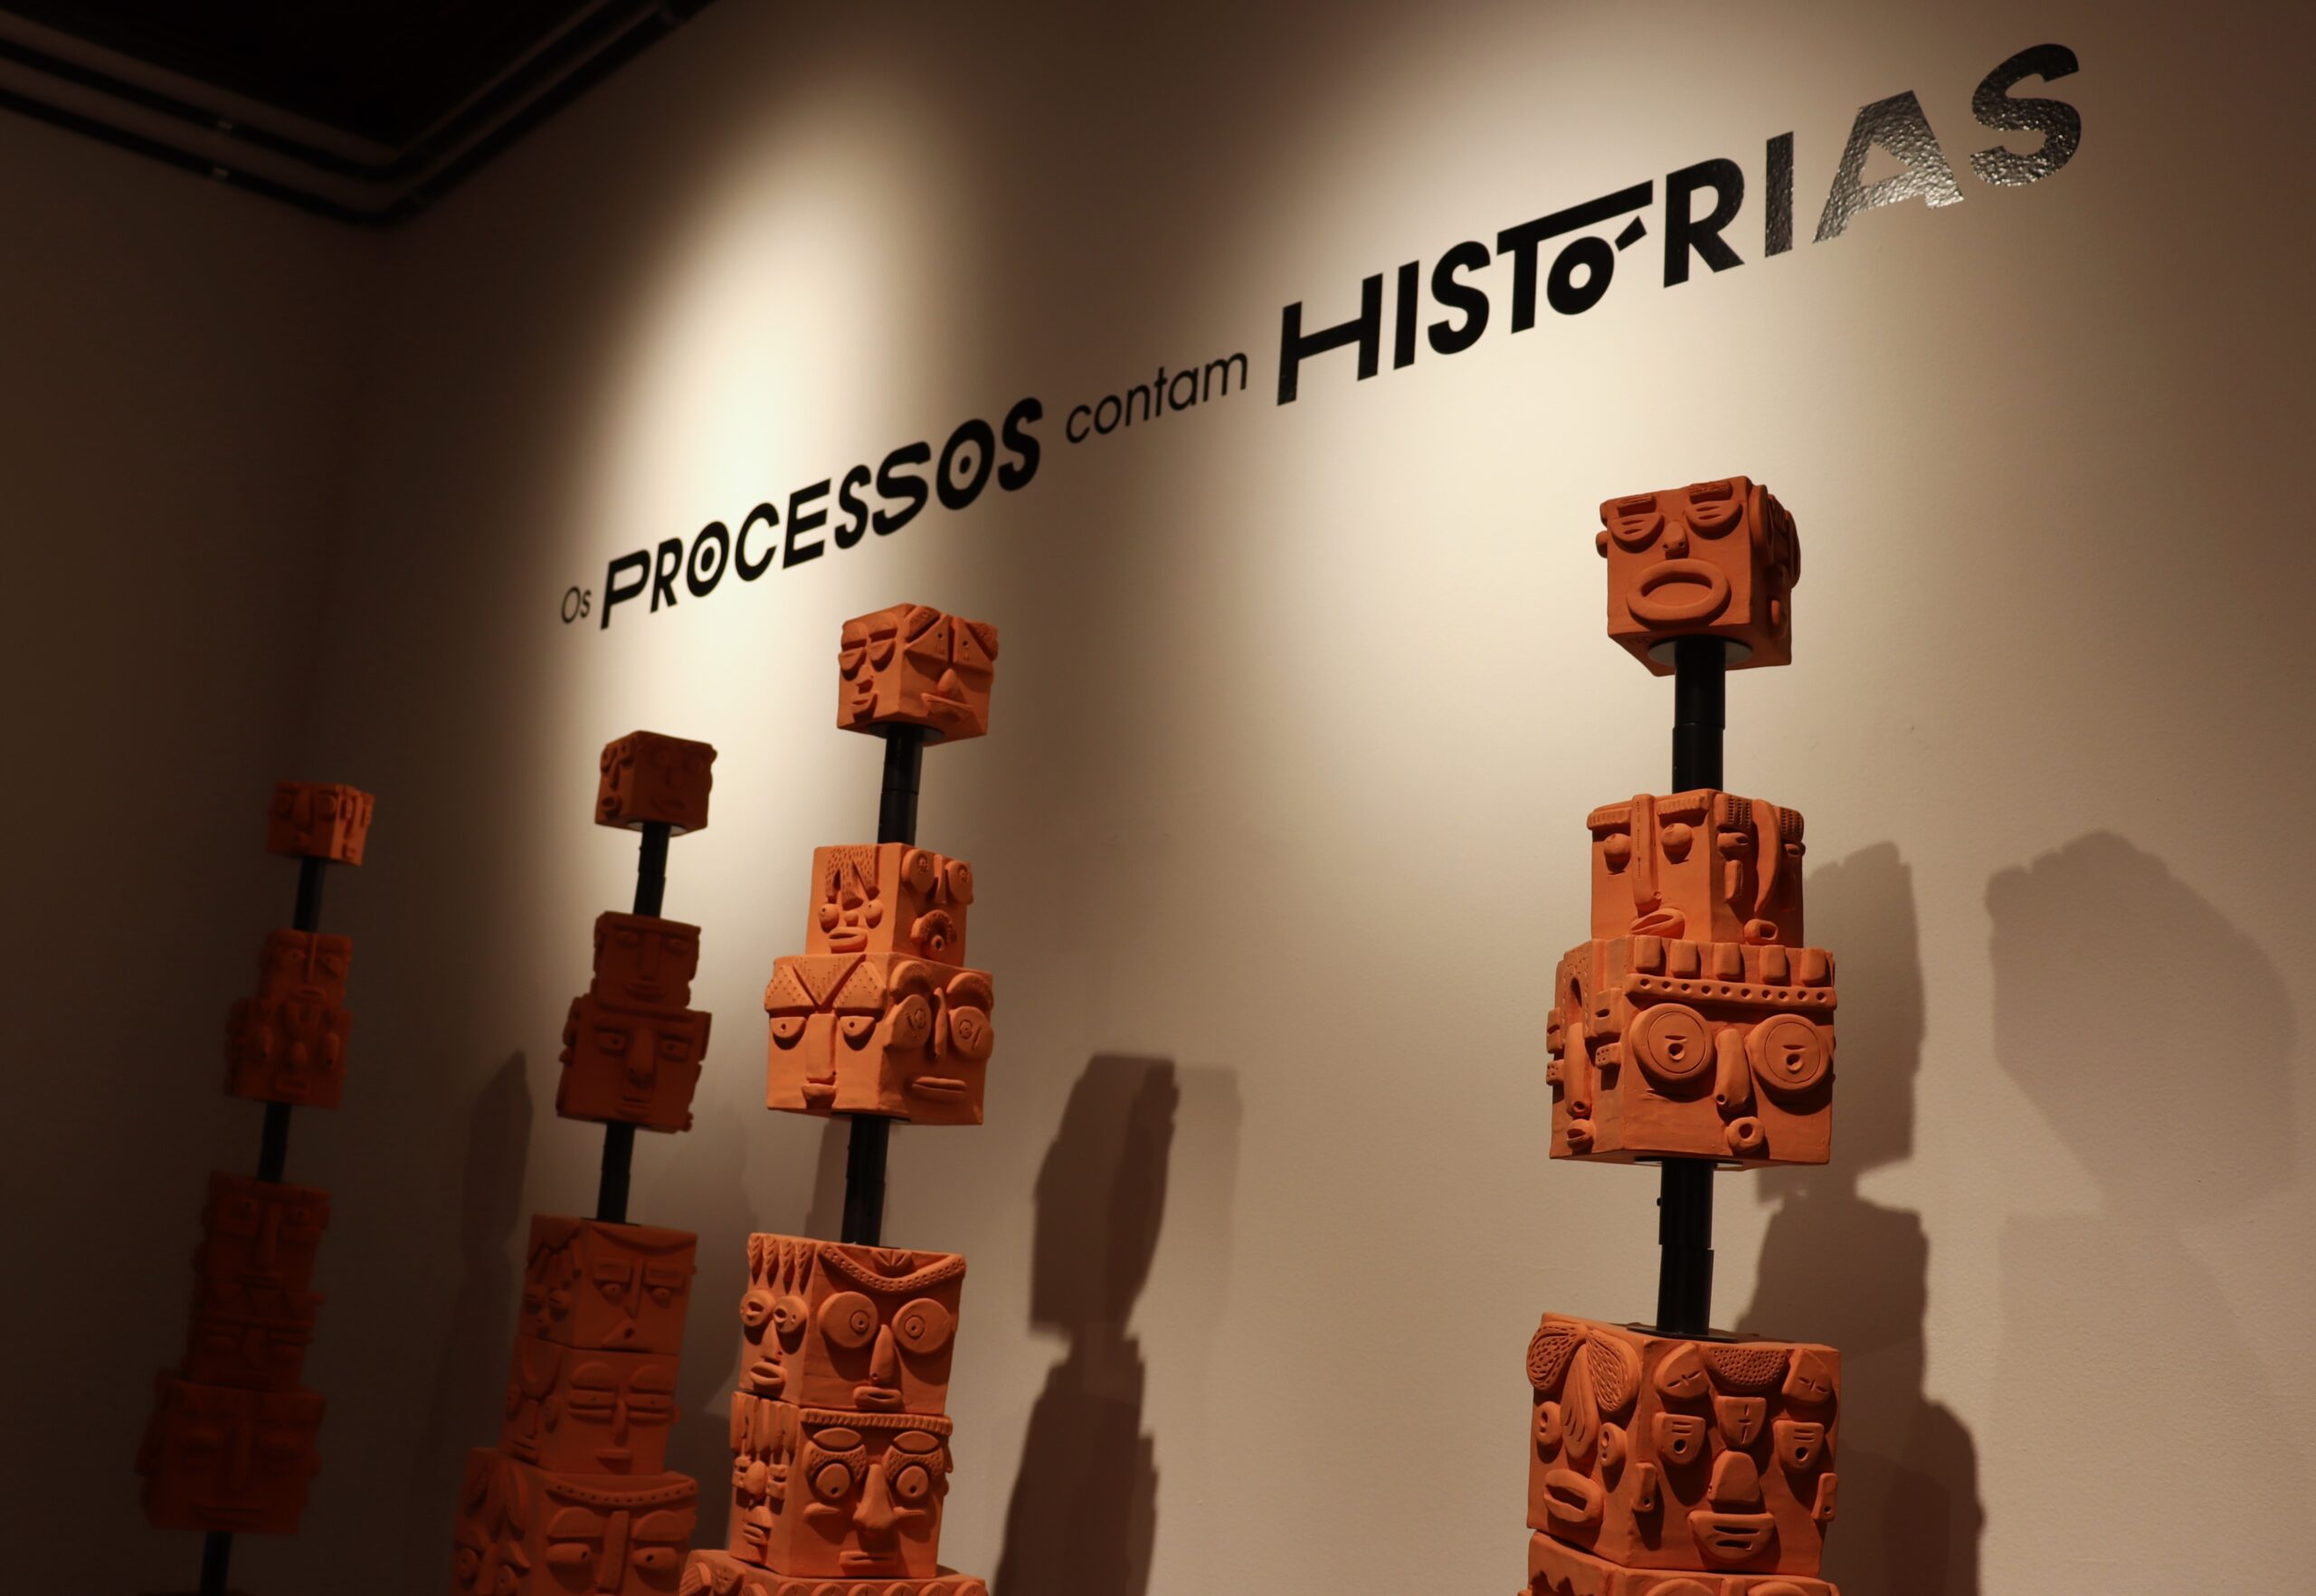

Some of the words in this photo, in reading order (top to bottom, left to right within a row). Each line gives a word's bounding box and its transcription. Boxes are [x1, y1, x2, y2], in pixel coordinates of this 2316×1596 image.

[561, 584, 592, 624] Os
[601, 396, 1043, 630] PROCESSOS
[1065, 351, 1248, 444] contam
[1277, 43, 2082, 406] HISTÓRIAS
